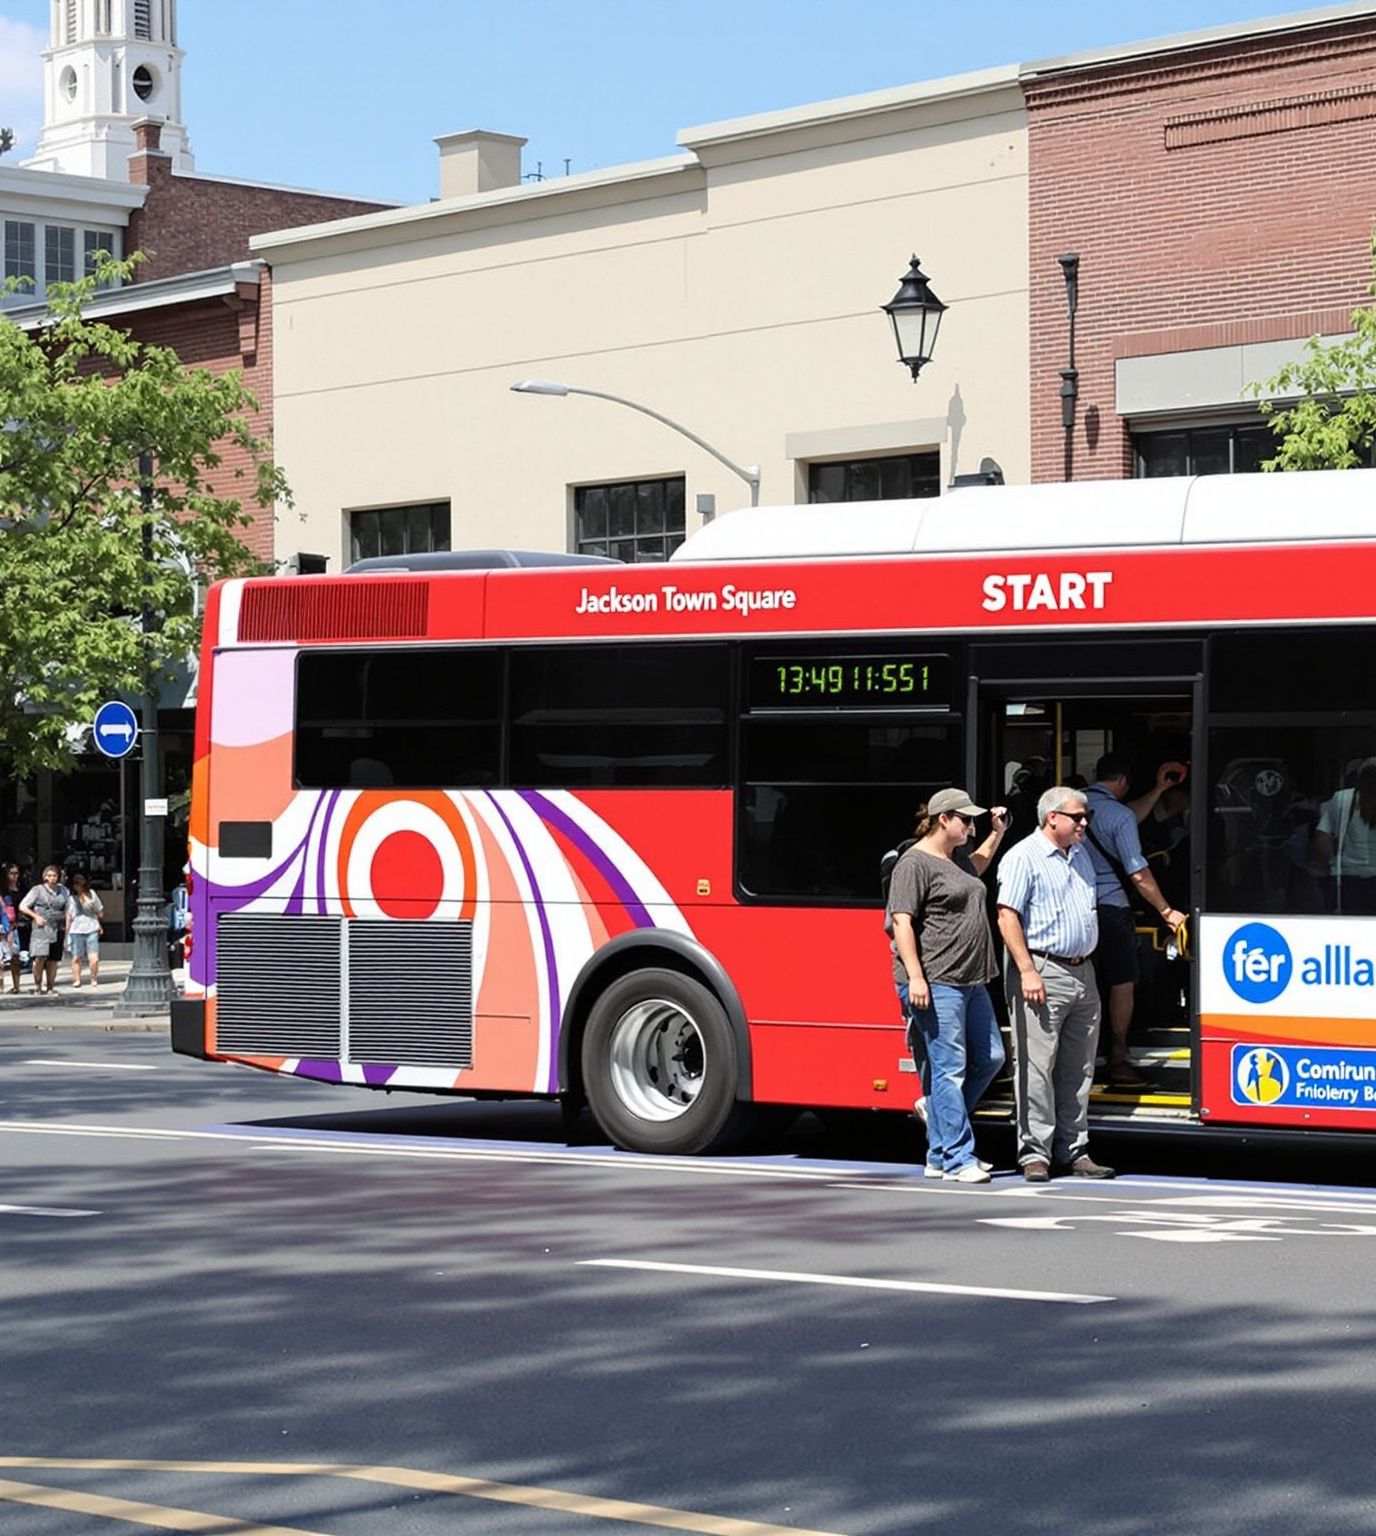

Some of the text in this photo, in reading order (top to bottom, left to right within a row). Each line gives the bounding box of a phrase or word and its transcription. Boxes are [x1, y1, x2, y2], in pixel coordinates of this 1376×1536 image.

[576, 584, 796, 616] Jackson Town Square
[982, 571, 1113, 612] START
